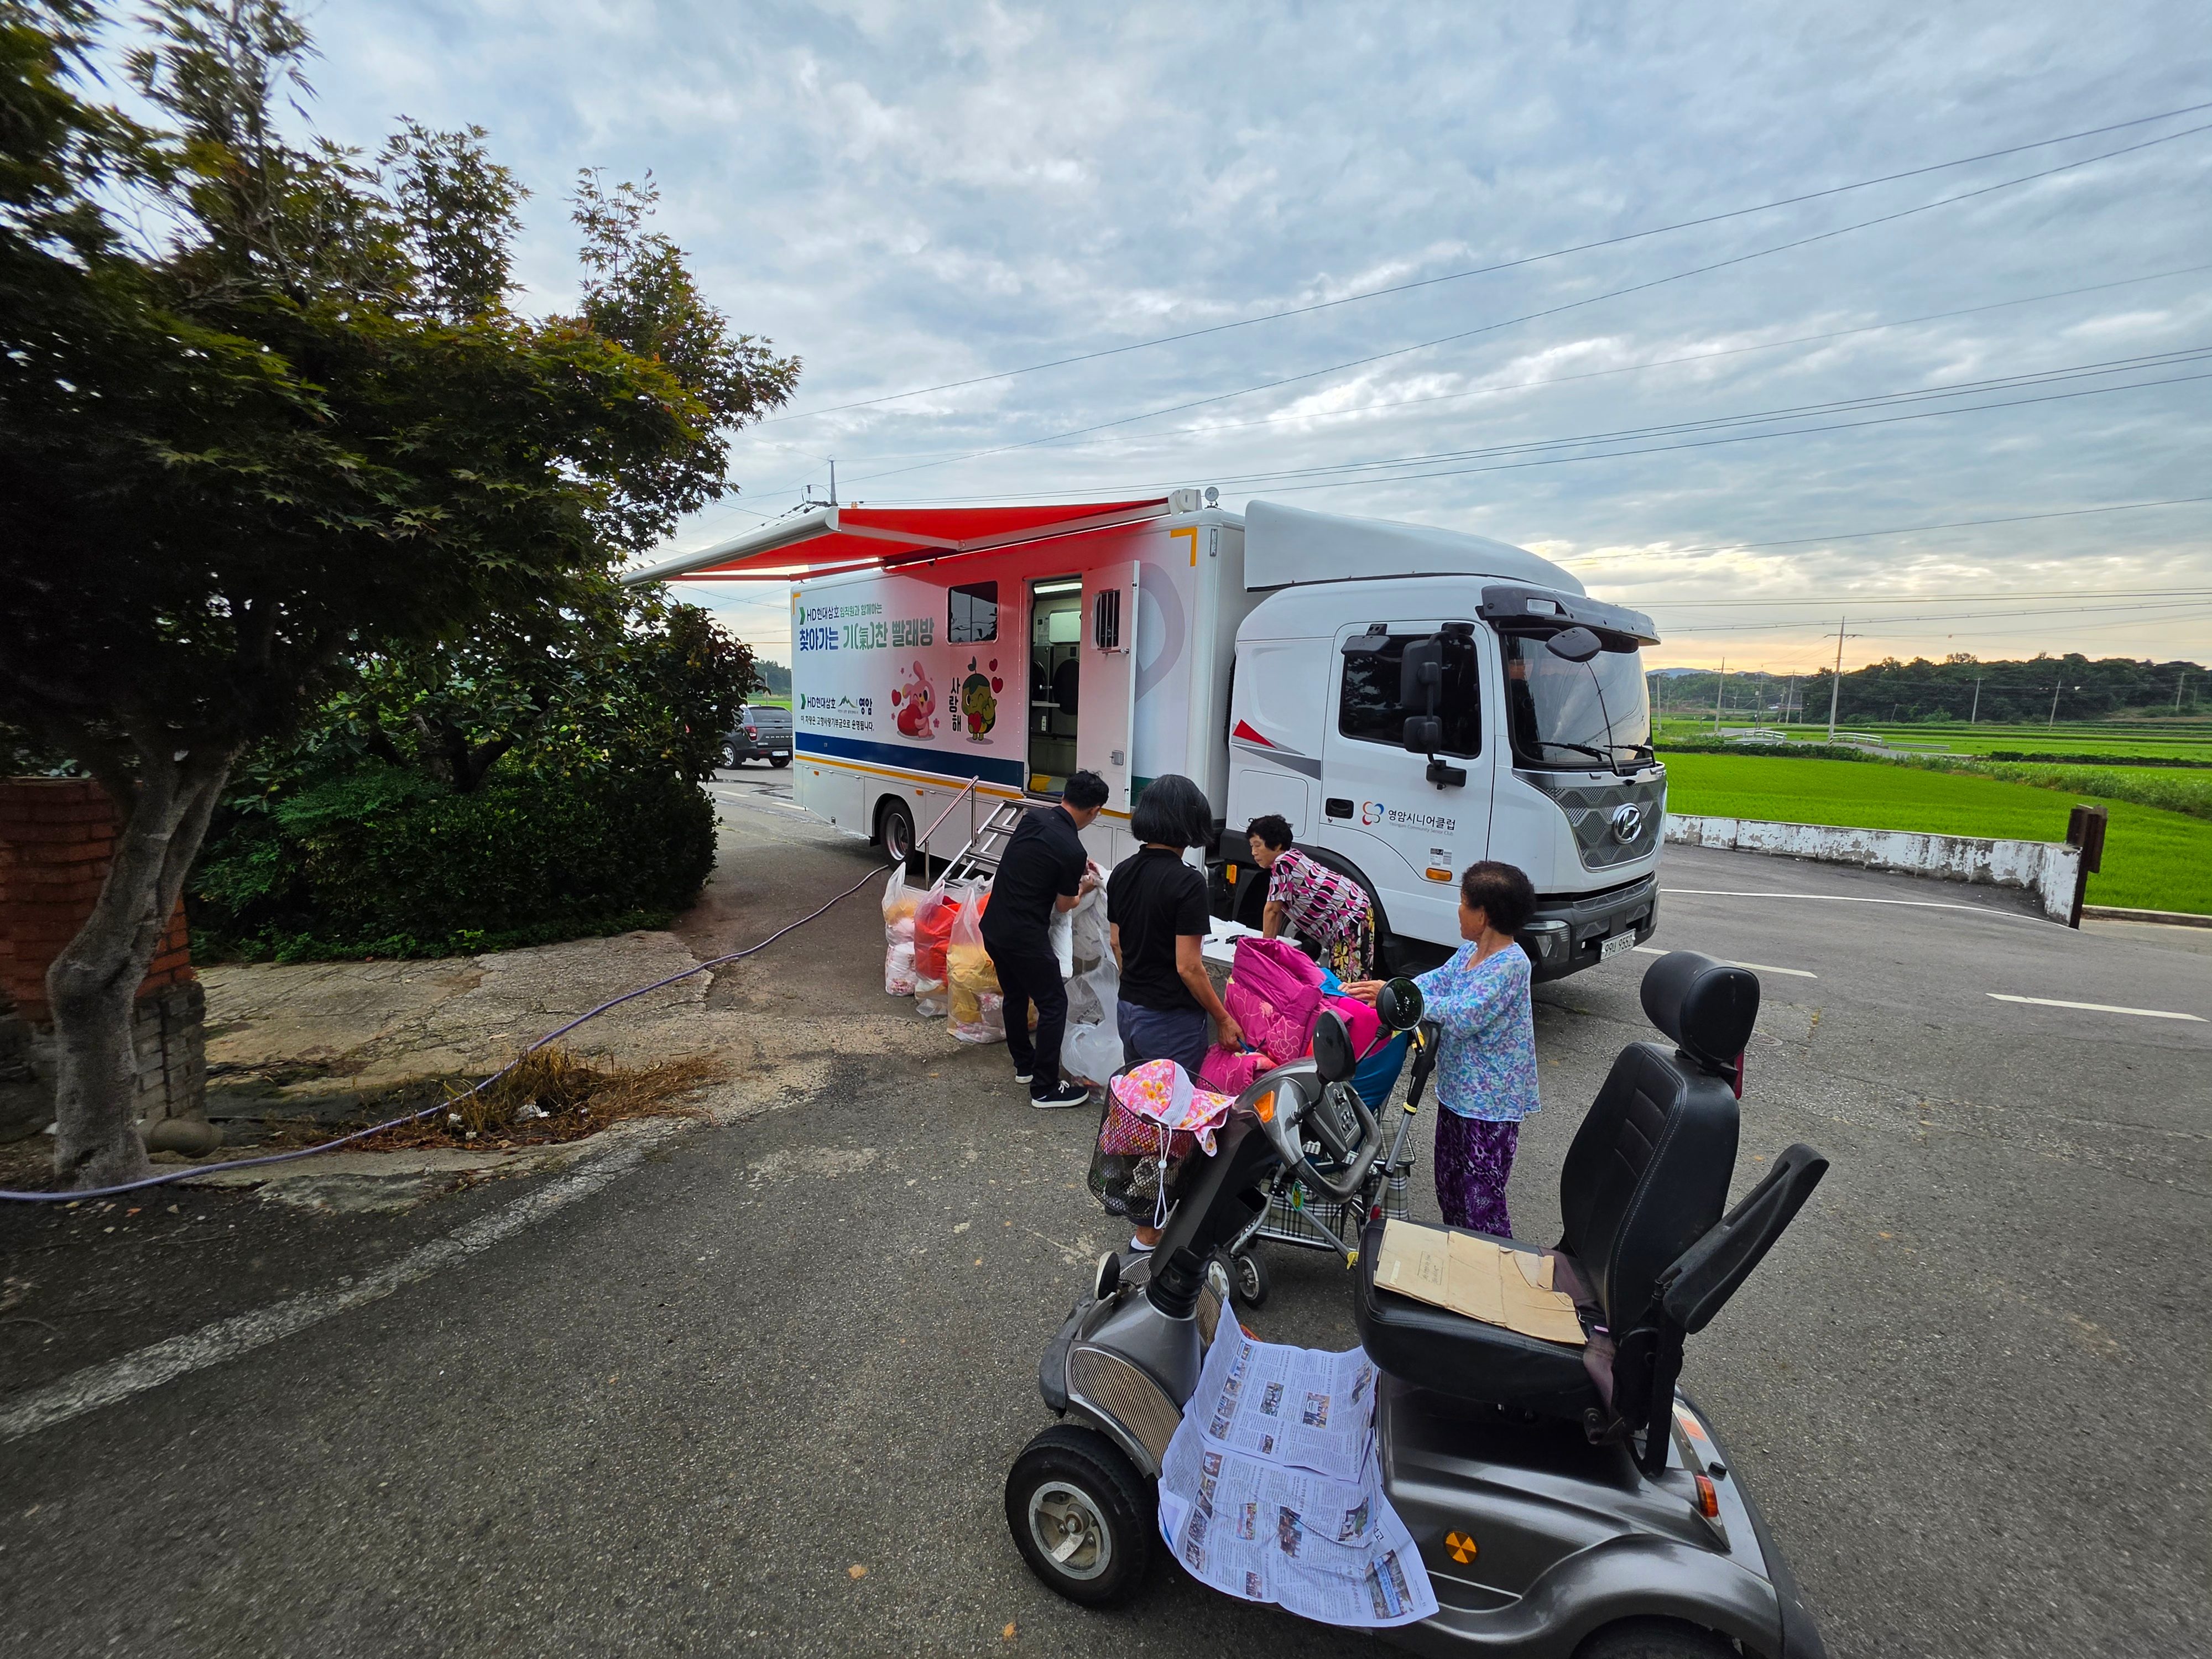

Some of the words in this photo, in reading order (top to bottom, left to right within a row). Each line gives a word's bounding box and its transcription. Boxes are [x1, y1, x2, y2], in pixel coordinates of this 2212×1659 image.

[807, 605, 839, 622] HD현대삼호
[840, 605, 860, 617] 임직원과
[861, 603, 883, 615] 함께하는
[800, 627, 838, 651] 찾아가는
[843, 621, 888, 650] 기(氣)찬
[892, 617, 935, 648] 빨래방
[807, 696, 836, 709] HD현대삼호
[859, 698, 873, 715] 영암
[949, 677, 961, 732] 사랑해
[801, 715, 805, 724] 이
[805, 716, 816, 725] 차량은
[817, 717, 851, 728] 고향사랑기부금으로
[1388, 810, 1456, 831] 영암시니어클럽
[1407, 825, 1430, 833] Community
[1619, 935, 1632, 952] 9552
